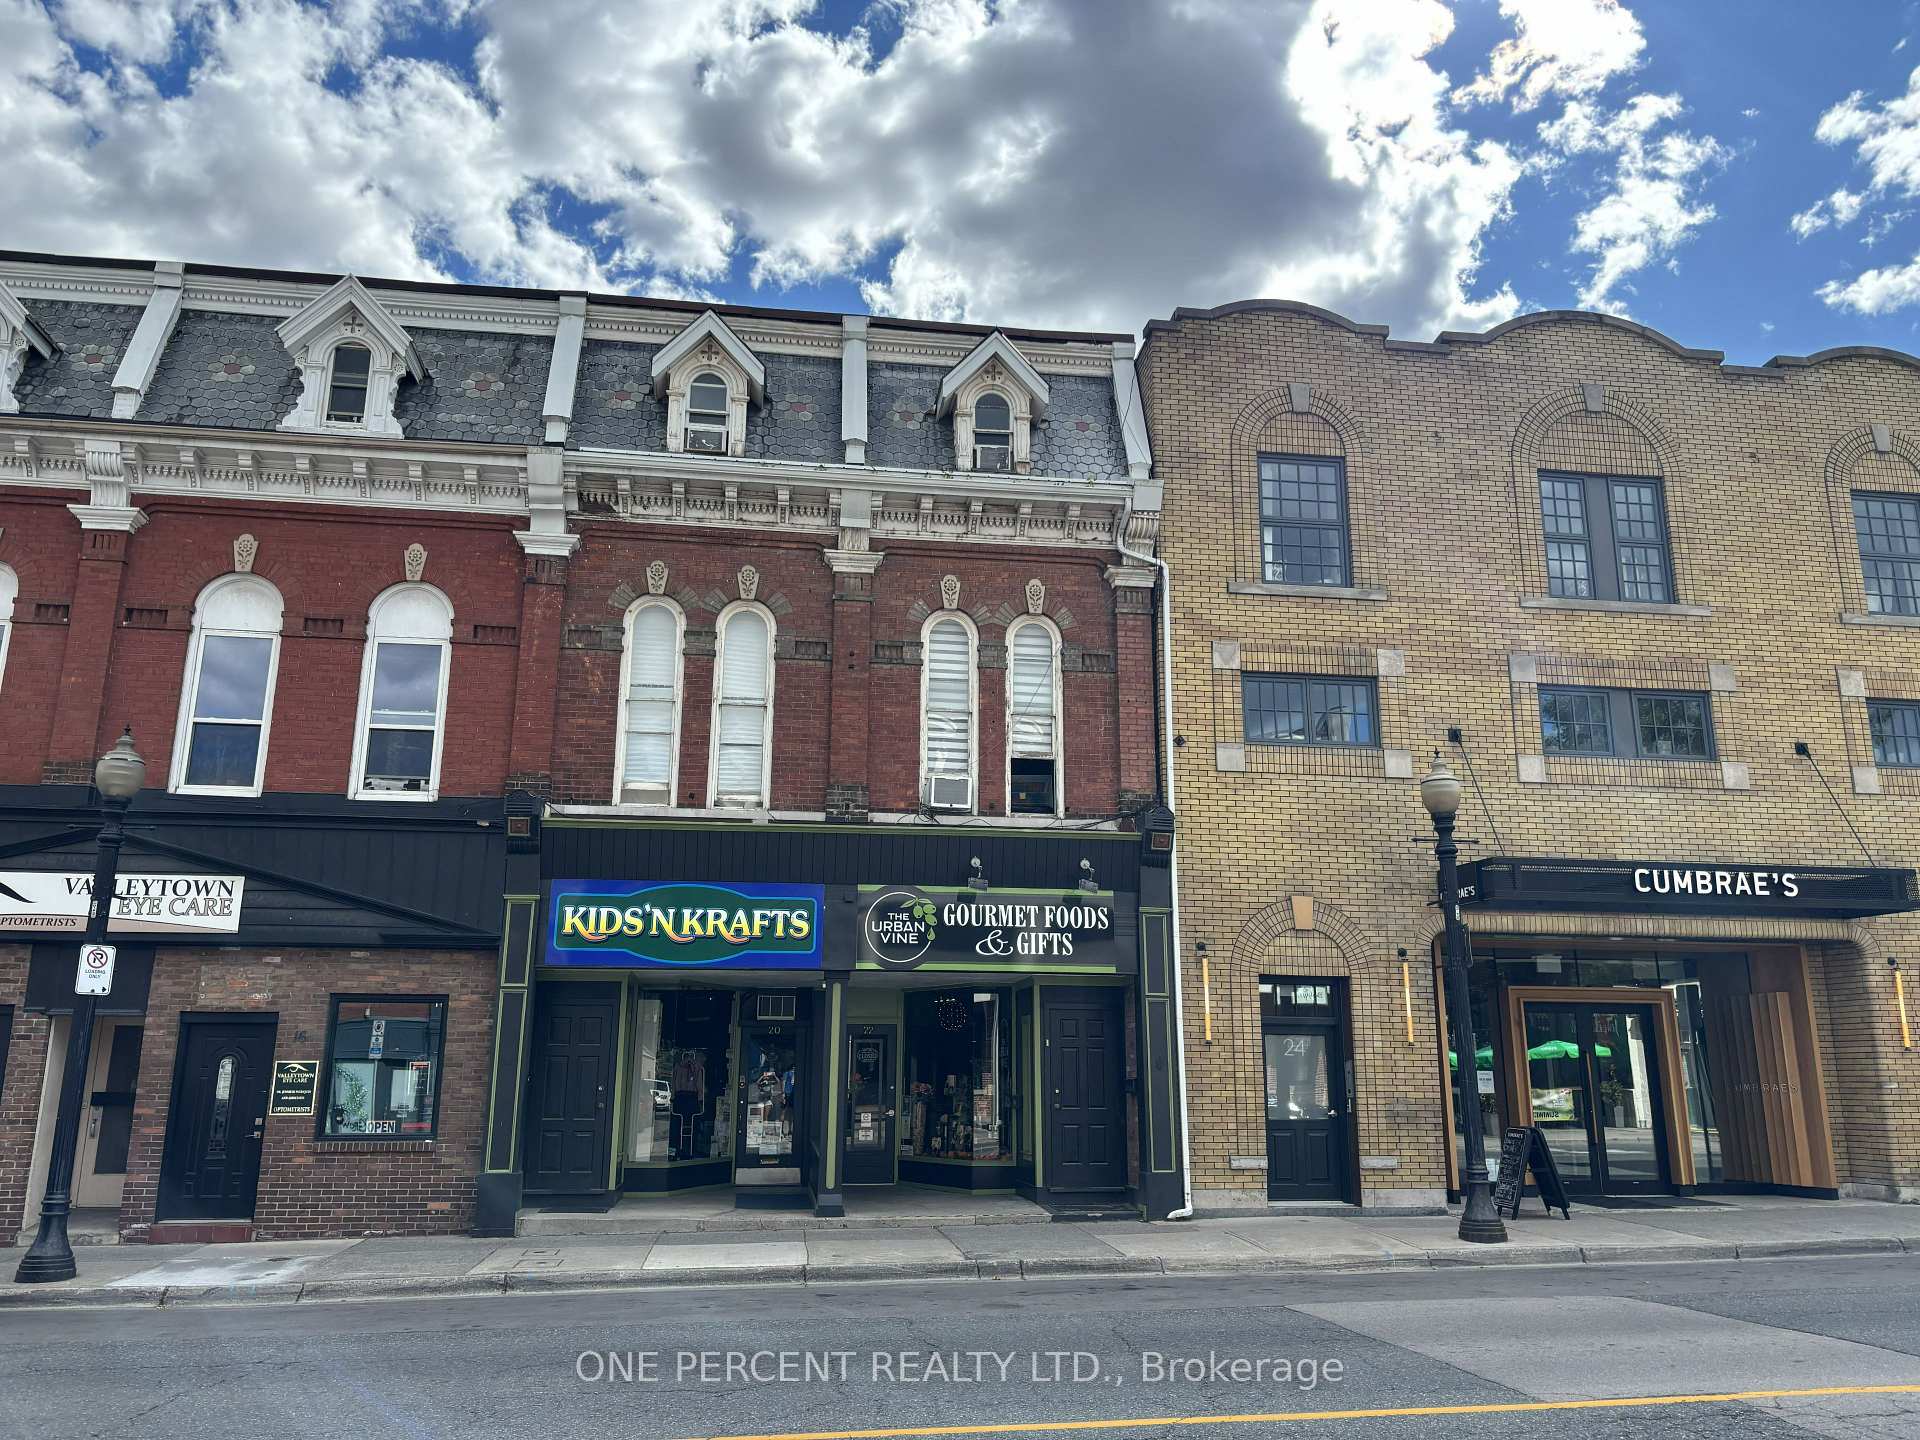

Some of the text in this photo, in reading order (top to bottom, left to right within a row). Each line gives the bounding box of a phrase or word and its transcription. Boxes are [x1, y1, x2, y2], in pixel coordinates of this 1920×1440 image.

[64, 877, 236, 897] VALEYTOWN
[1633, 868, 1799, 898] CUMBRAE'S
[117, 897, 163, 916] EYE
[168, 897, 234, 917] CARE
[887, 912, 910, 921] THE
[0, 916, 77, 927] PTOMETRISTS
[682, 908, 810, 943] KRAFTS
[871, 920, 925, 933] URBAN
[943, 904, 1109, 930] GOURMET FOODS
[880, 932, 919, 944] VINE
[975, 929, 1073, 956] & GIFTS
[768, 1026, 781, 1035] 20
[1283, 1038, 1306, 1057] 24
[367, 1121, 396, 1133] OPEN
